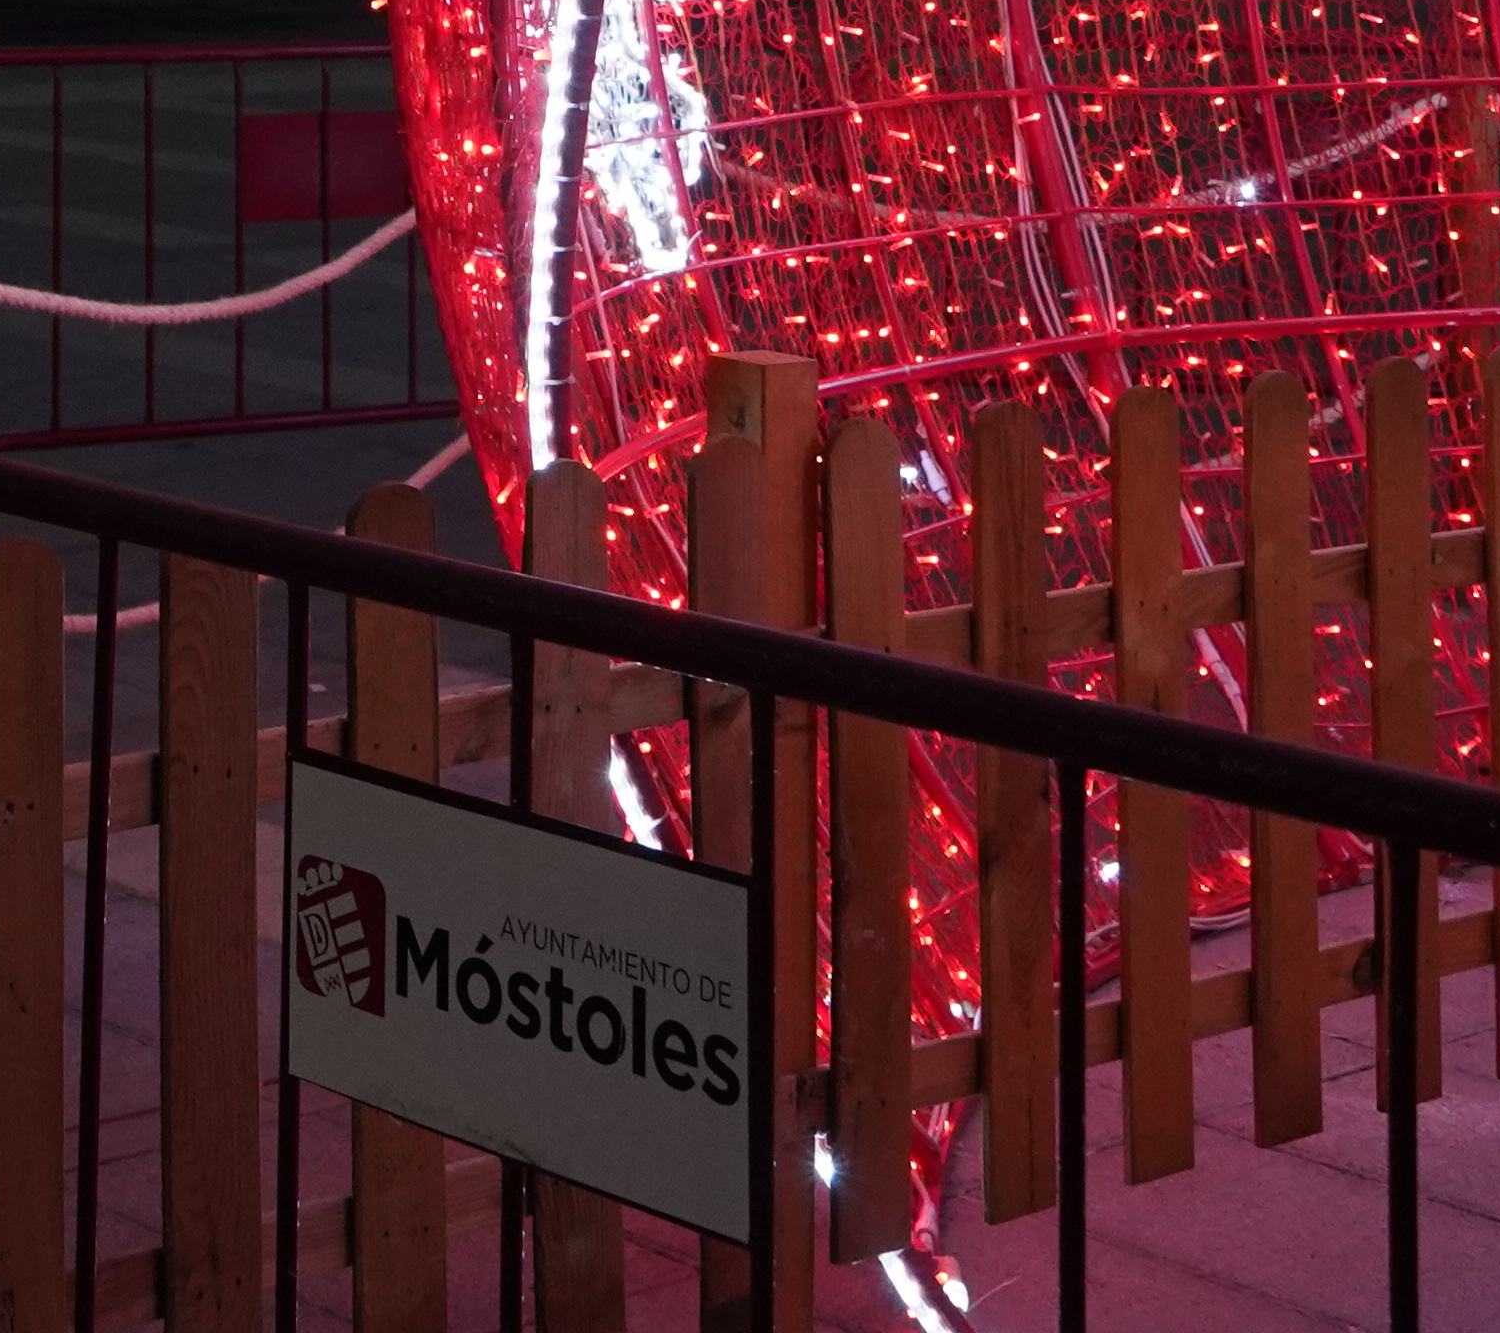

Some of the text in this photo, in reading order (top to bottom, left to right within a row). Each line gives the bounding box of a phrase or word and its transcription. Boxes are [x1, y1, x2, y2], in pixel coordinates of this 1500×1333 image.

[396, 915, 740, 1105] Móstoles
[500, 915, 732, 1009] AYUNTAMIENTO DE
